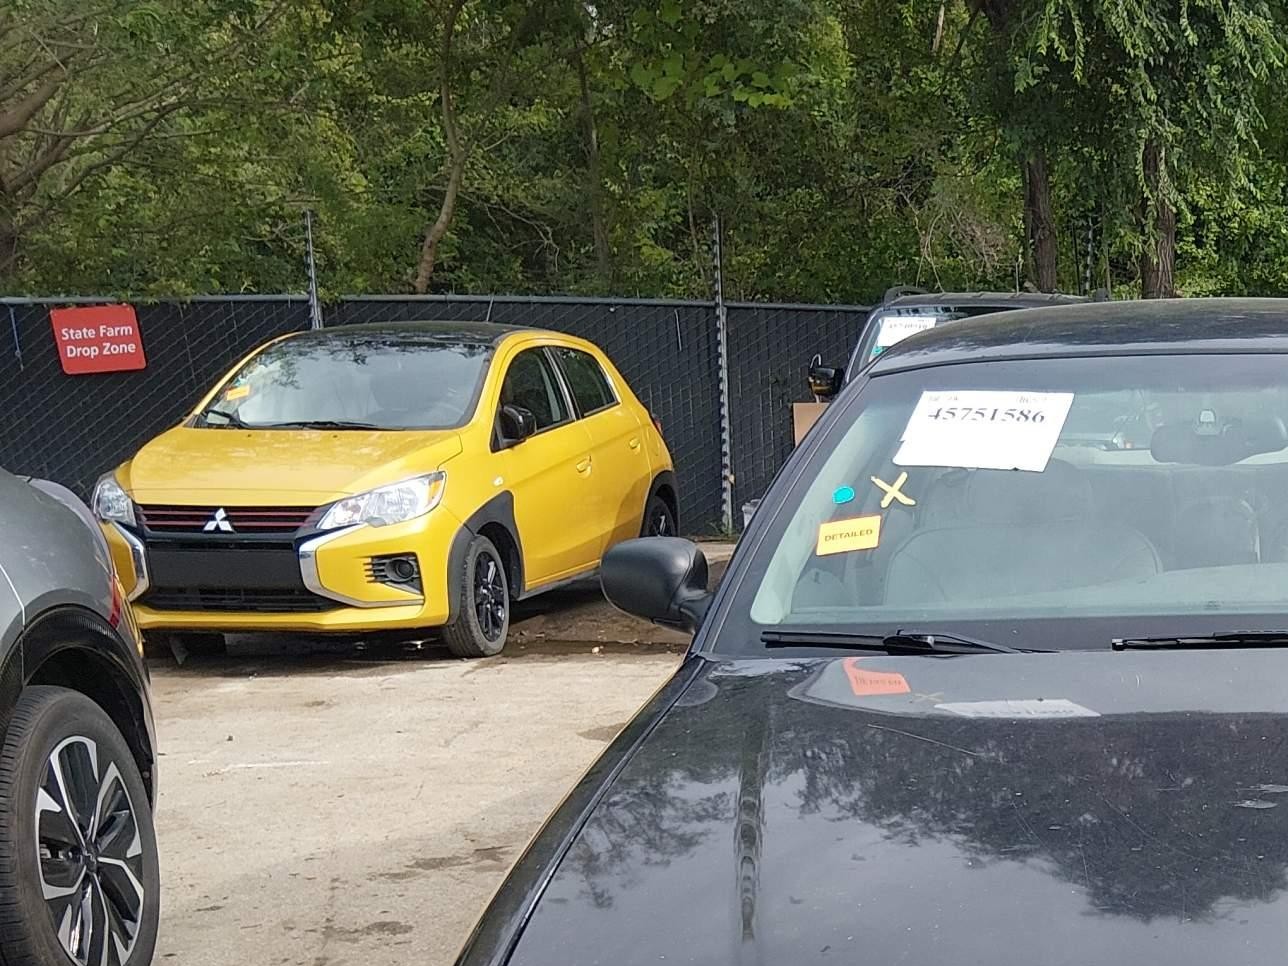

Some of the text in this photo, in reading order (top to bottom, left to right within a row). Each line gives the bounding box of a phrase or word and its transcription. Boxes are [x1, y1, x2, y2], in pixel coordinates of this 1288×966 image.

[61, 325, 133, 340] State Farm
[66, 342, 136, 359] Drop Zone
[927, 407, 1045, 423] 45751586
[824, 528, 873, 542] DETAILED
